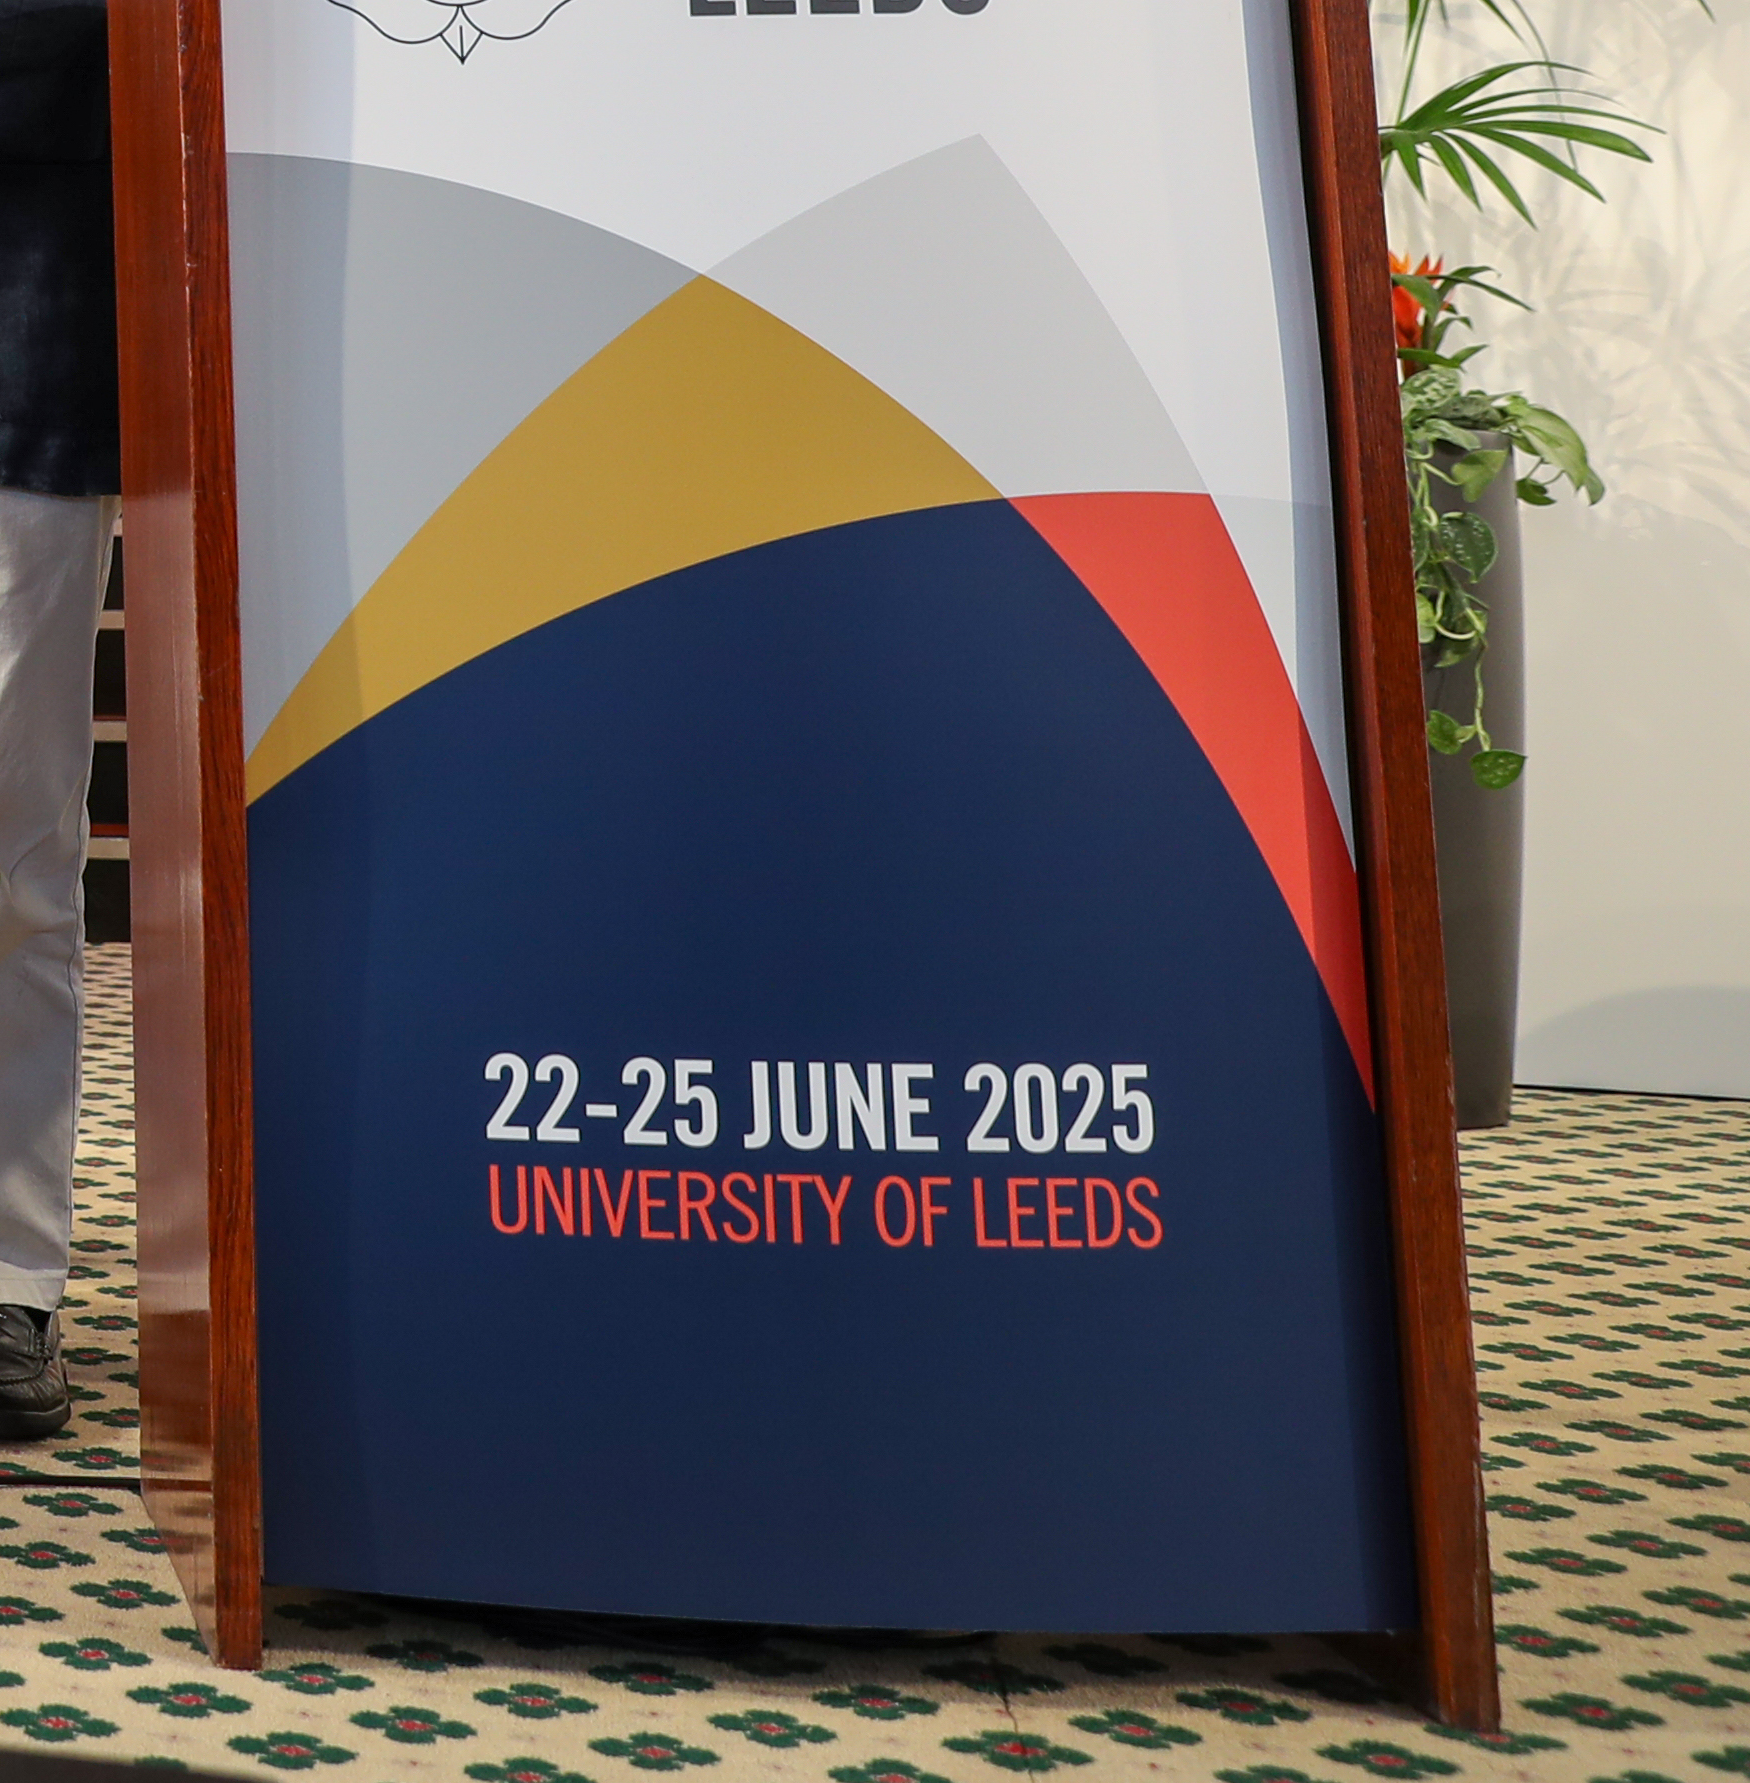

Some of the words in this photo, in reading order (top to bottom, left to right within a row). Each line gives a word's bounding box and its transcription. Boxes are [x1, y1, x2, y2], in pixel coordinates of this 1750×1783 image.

[483, 1052, 720, 1148] 22-25
[743, 1060, 941, 1152] JUNE
[964, 1062, 1156, 1153] 2025
[487, 1163, 853, 1246] UNIVERSITY
[874, 1175, 952, 1248] OF
[972, 1176, 1164, 1248] LEEDS
